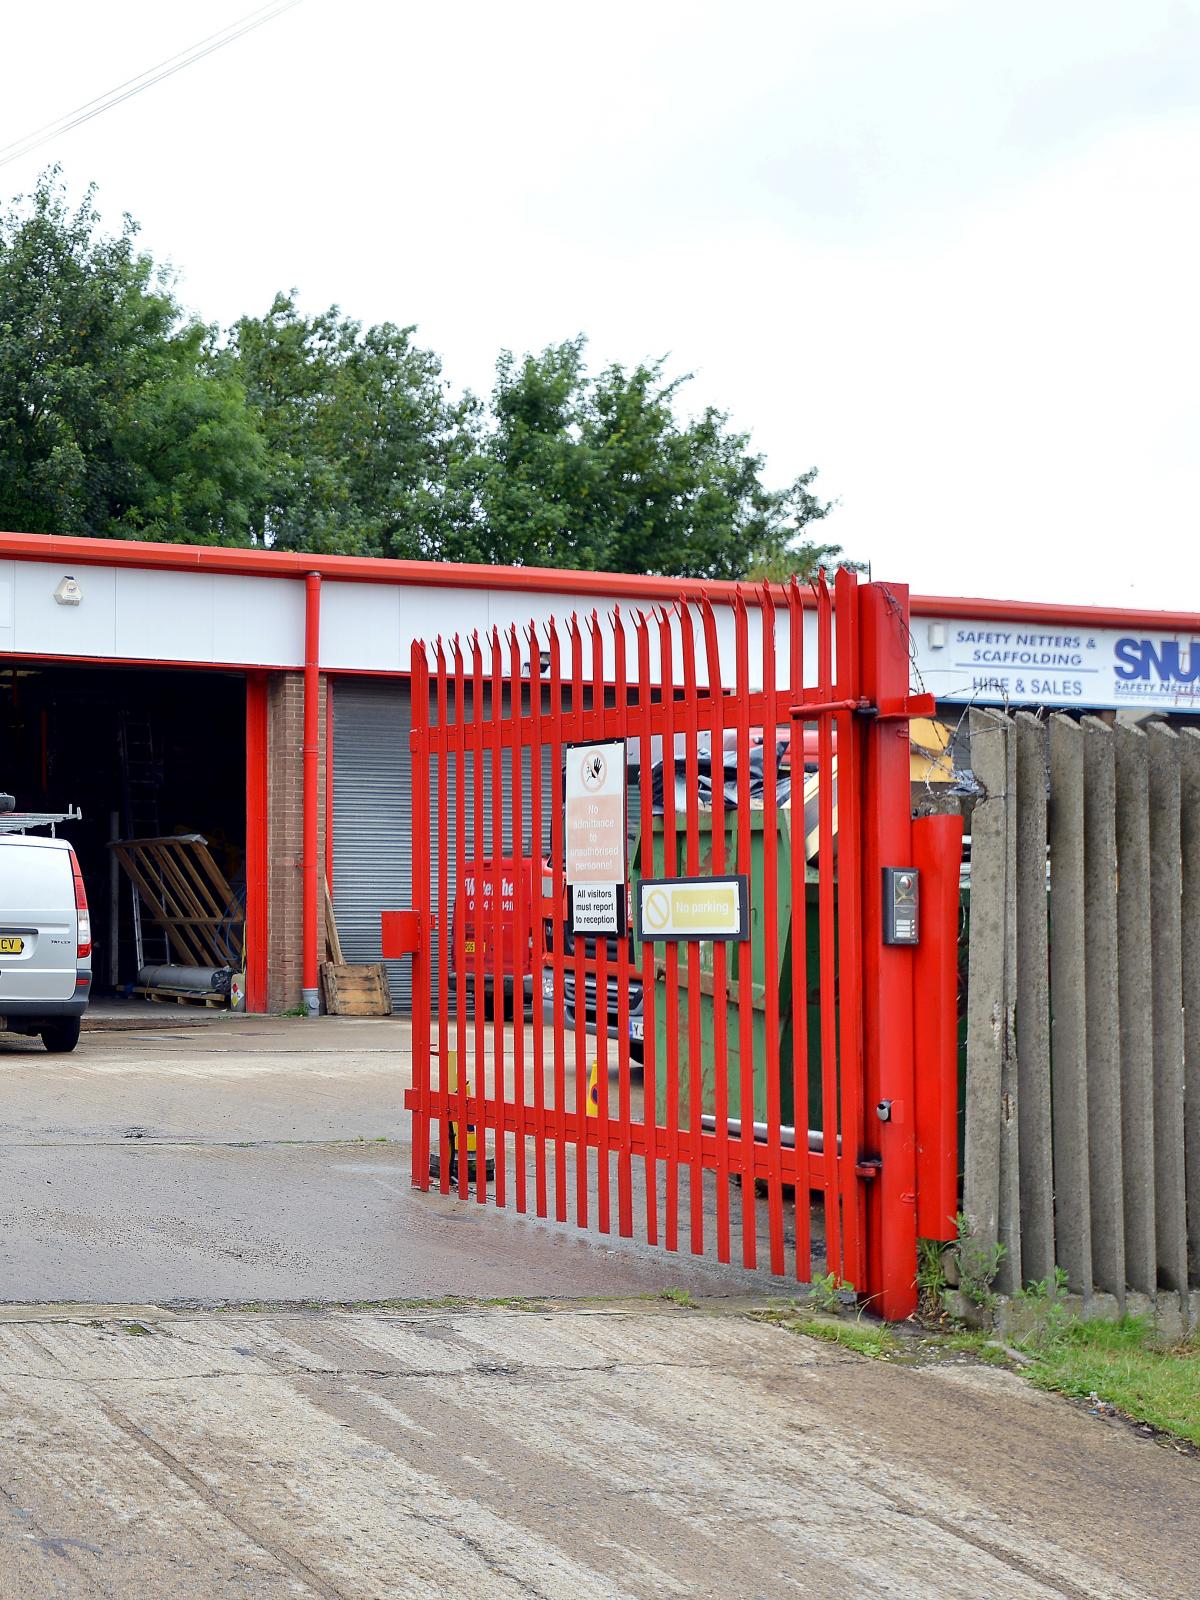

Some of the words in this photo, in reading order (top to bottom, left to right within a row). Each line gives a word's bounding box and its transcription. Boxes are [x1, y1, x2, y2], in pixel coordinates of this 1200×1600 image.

[956, 630, 1011, 645] SAFETY
[1016, 632, 1080, 649] NETTERS
[1086, 637, 1096, 649] &
[972, 649, 1082, 666] SCAFFOLDING
[972, 677, 1009, 694] HIRE
[1015, 679, 1025, 695] &
[1032, 680, 1082, 696] SALES
[1114, 681, 1155, 692] SAFETY
[588, 804, 599, 815] No
[573, 818, 615, 829] admittance
[589, 832, 597, 842] to
[570, 845, 618, 857] unauthorised
[575, 860, 613, 872] personnel
[577, 890, 586, 898] All
[587, 889, 612, 898] visitors
[593, 903, 614, 913] report
[676, 901, 689, 913] No
[691, 900, 729, 916] parking
[576, 916, 582, 924] to
[583, 915, 615, 926] reception
